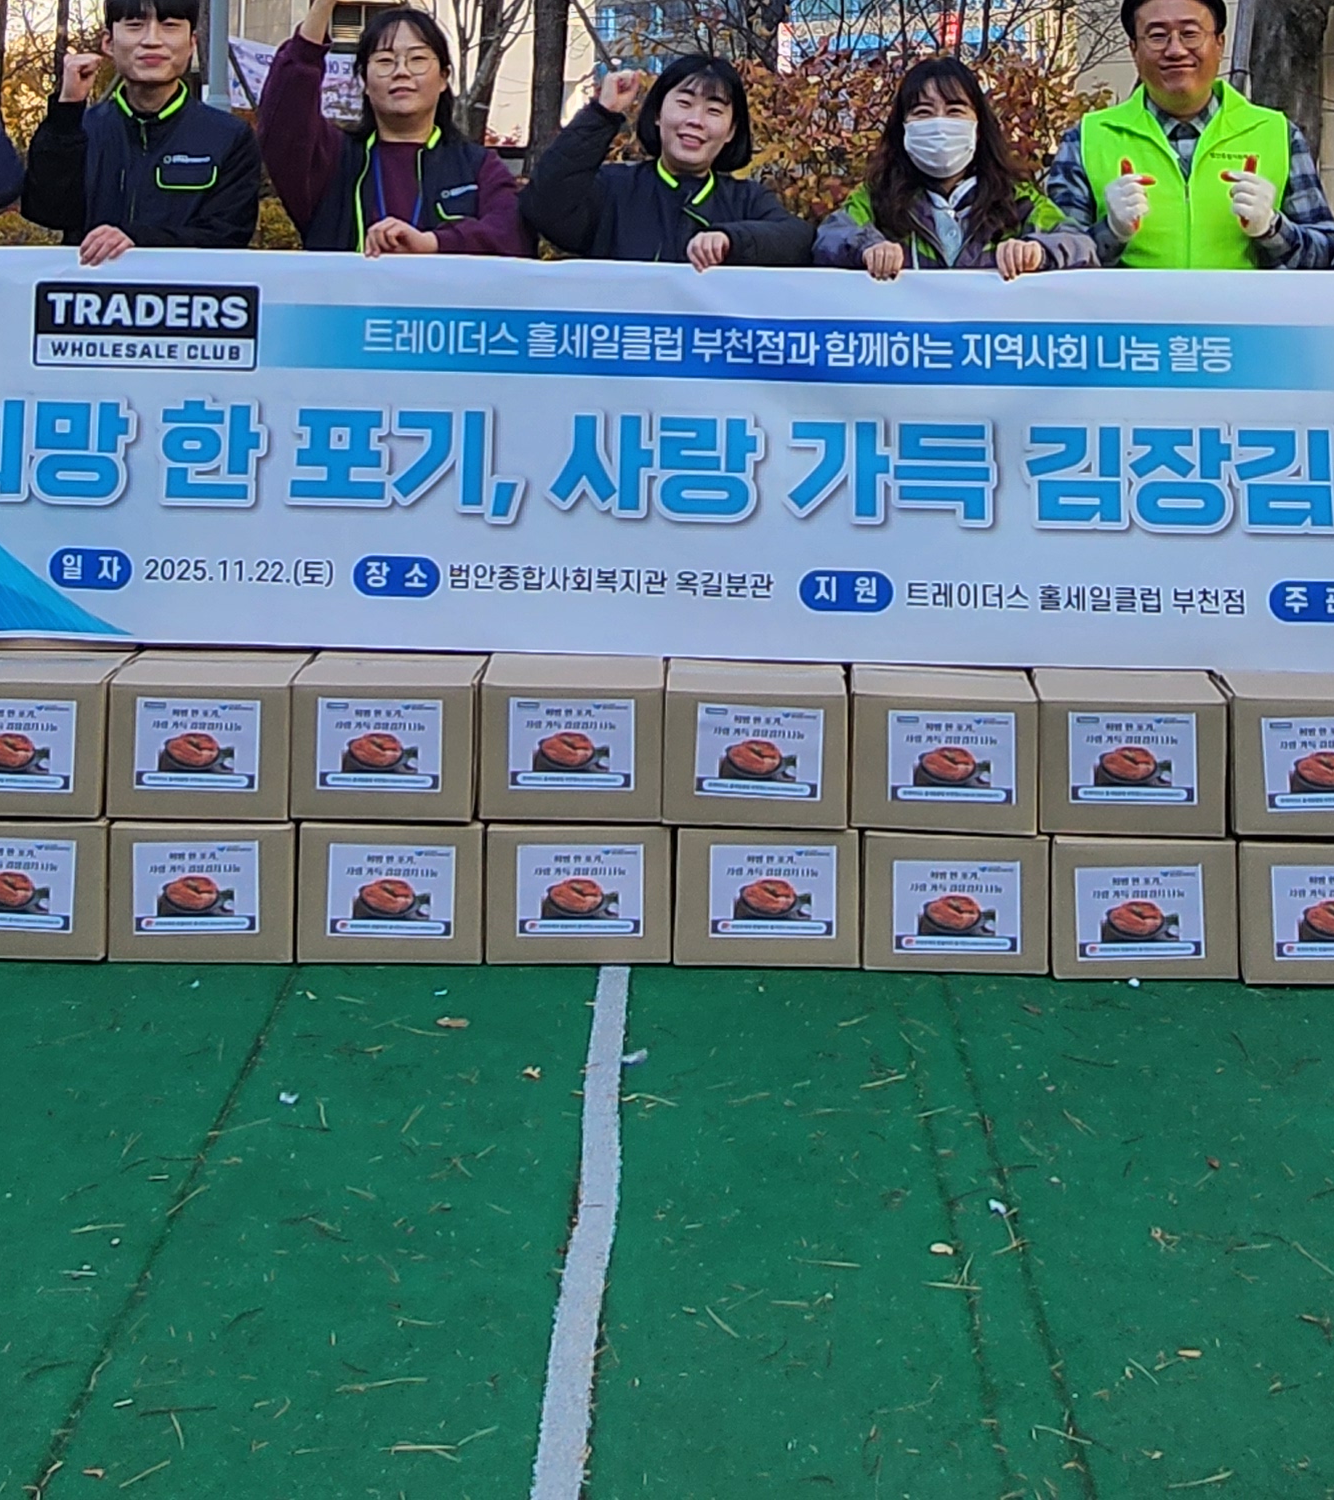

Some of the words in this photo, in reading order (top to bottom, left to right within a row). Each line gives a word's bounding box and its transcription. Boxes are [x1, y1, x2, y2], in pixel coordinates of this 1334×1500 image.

[47, 292, 249, 329] TRADERS
[50, 340, 179, 360] WHOLESALE
[186, 344, 241, 361] CLUB
[363, 318, 519, 357] 트레이더스
[527, 321, 684, 362] 홀세일클럽
[691, 327, 819, 367] 부천점과
[825, 330, 954, 369] 함께하는
[961, 332, 1088, 370] 지역사회
[1097, 334, 1161, 372] 나눔
[1168, 335, 1234, 374] 활동
[159, 397, 264, 503] 한
[285, 404, 522, 521] 포기,
[545, 410, 761, 519] 사랑
[783, 417, 994, 524] 가득
[143, 558, 335, 588] 2025.11.22.(토)
[449, 563, 668, 595] 범안종합사회복지관
[675, 570, 775, 599] 옥길분관
[905, 581, 1030, 610] 트레이더스
[1038, 583, 1162, 613] 홀세일클럽
[1172, 586, 1246, 615] 부천점
